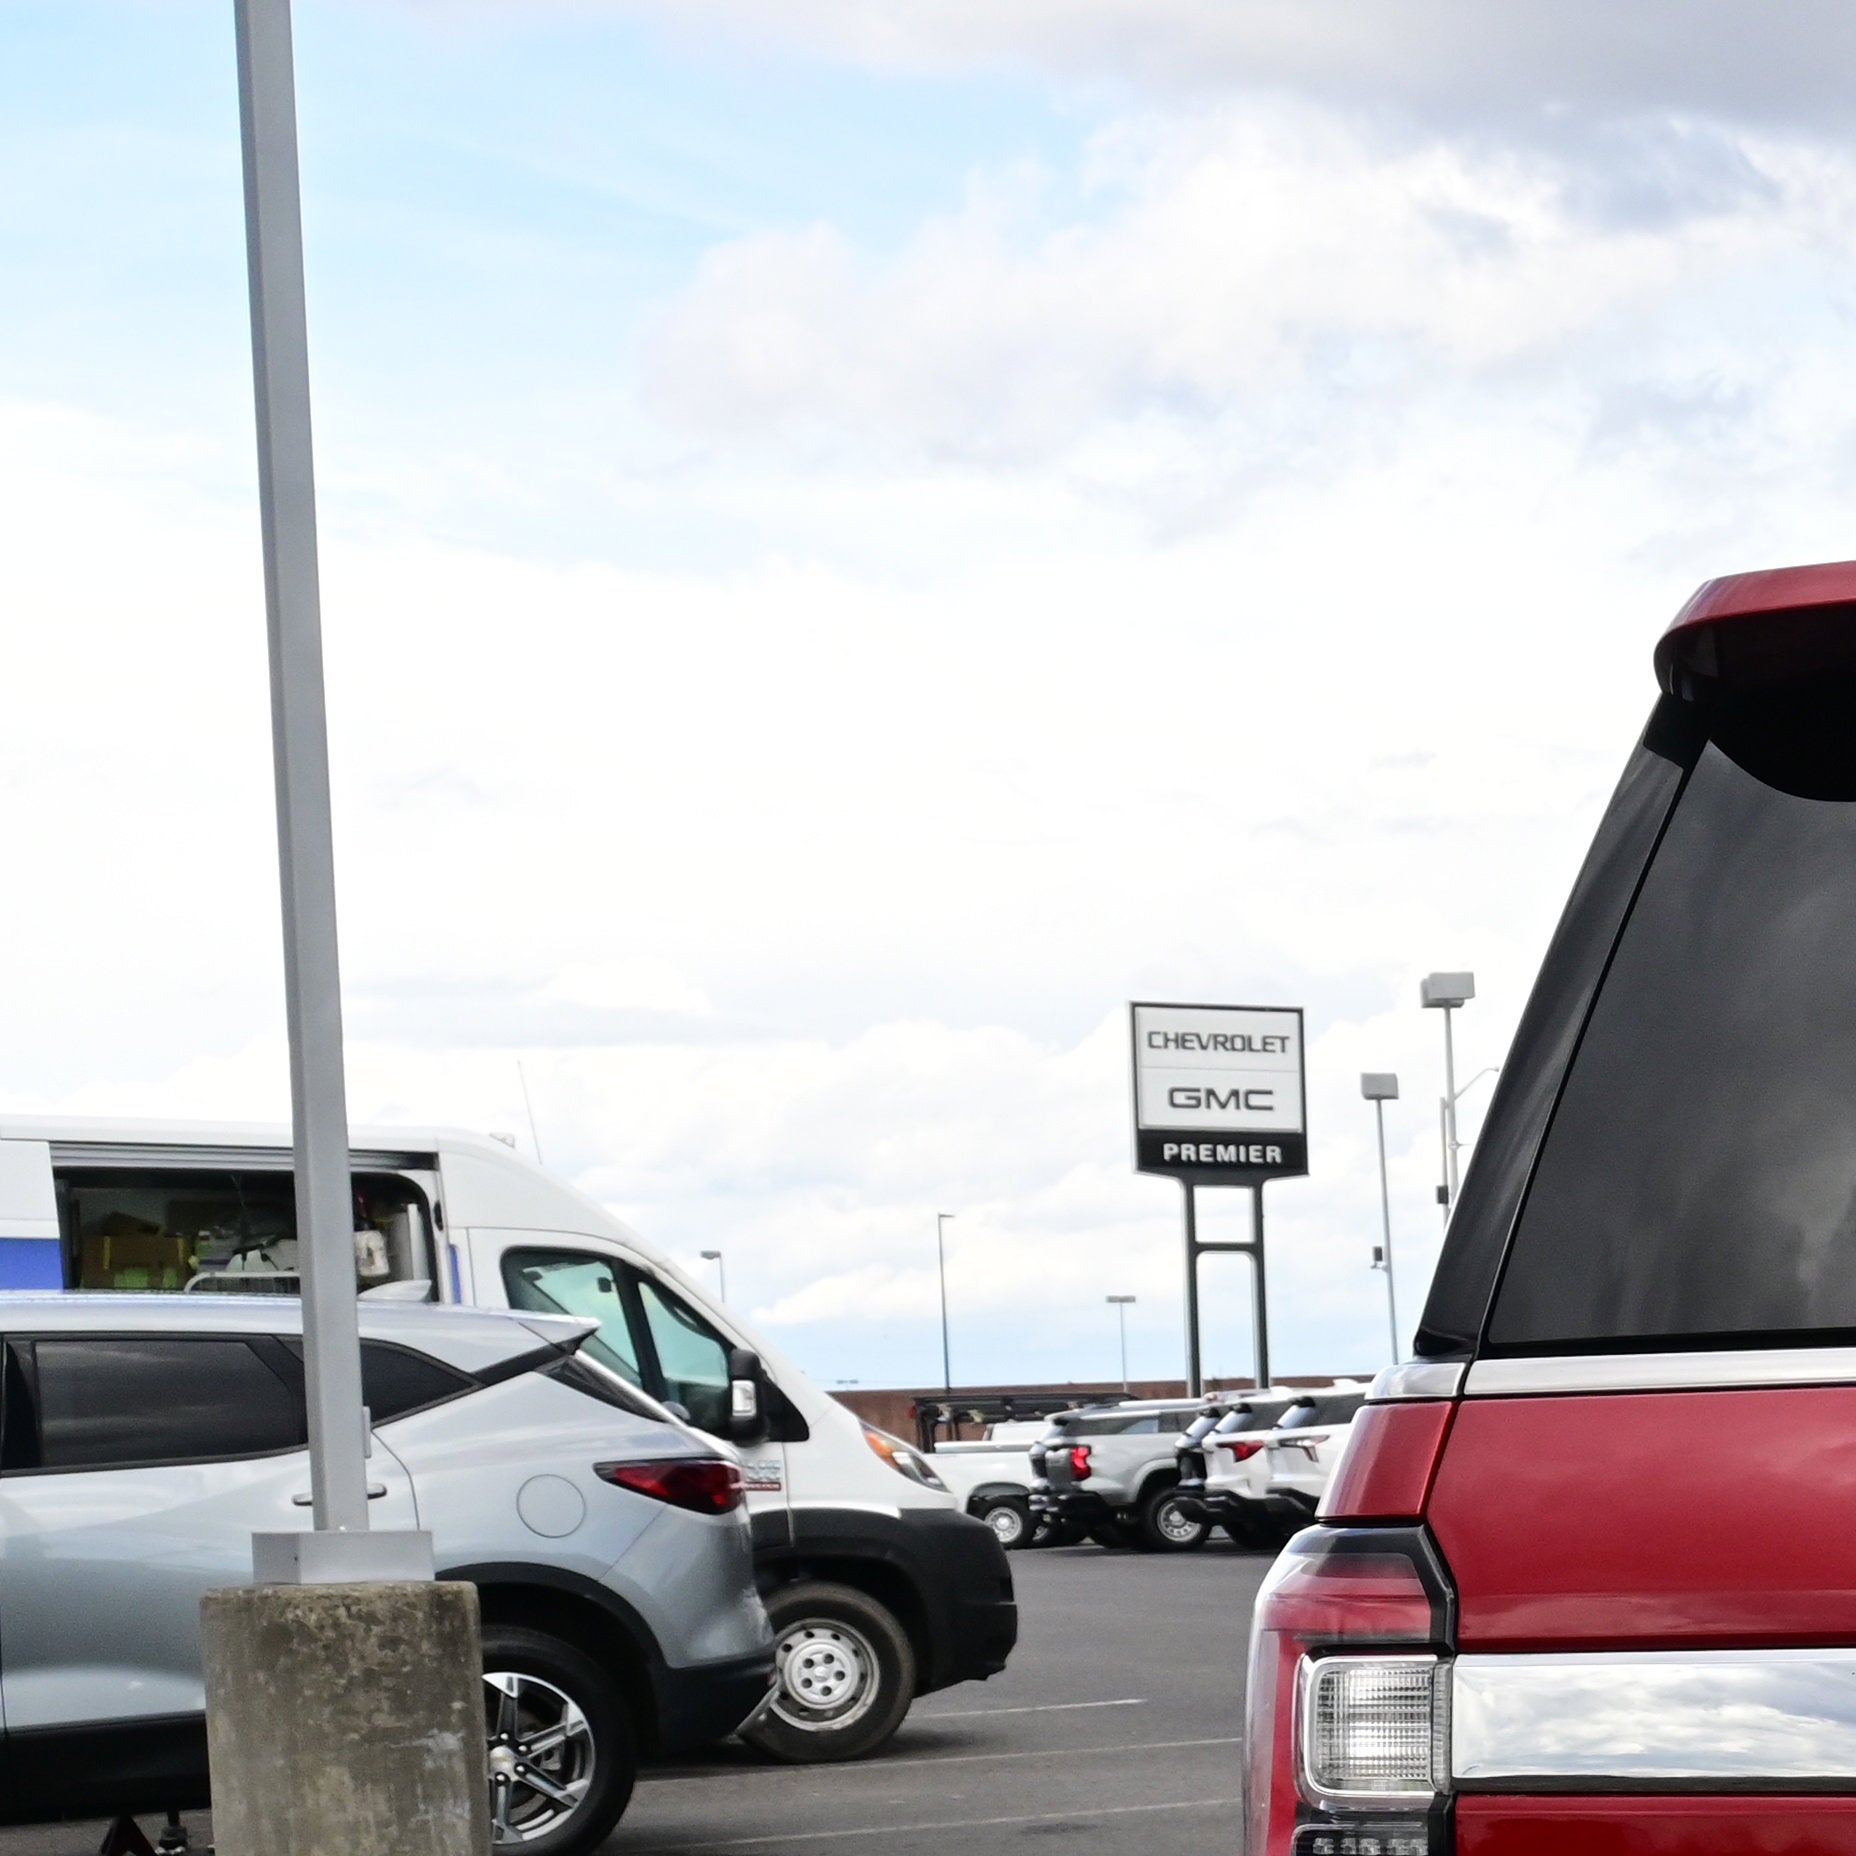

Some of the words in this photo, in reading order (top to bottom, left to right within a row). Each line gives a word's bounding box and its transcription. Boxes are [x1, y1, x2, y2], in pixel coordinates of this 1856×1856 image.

[1147, 1031, 1290, 1053] CHEVROLET
[1168, 1086, 1275, 1111] GMC
[1162, 1142, 1283, 1165] PREMIER
